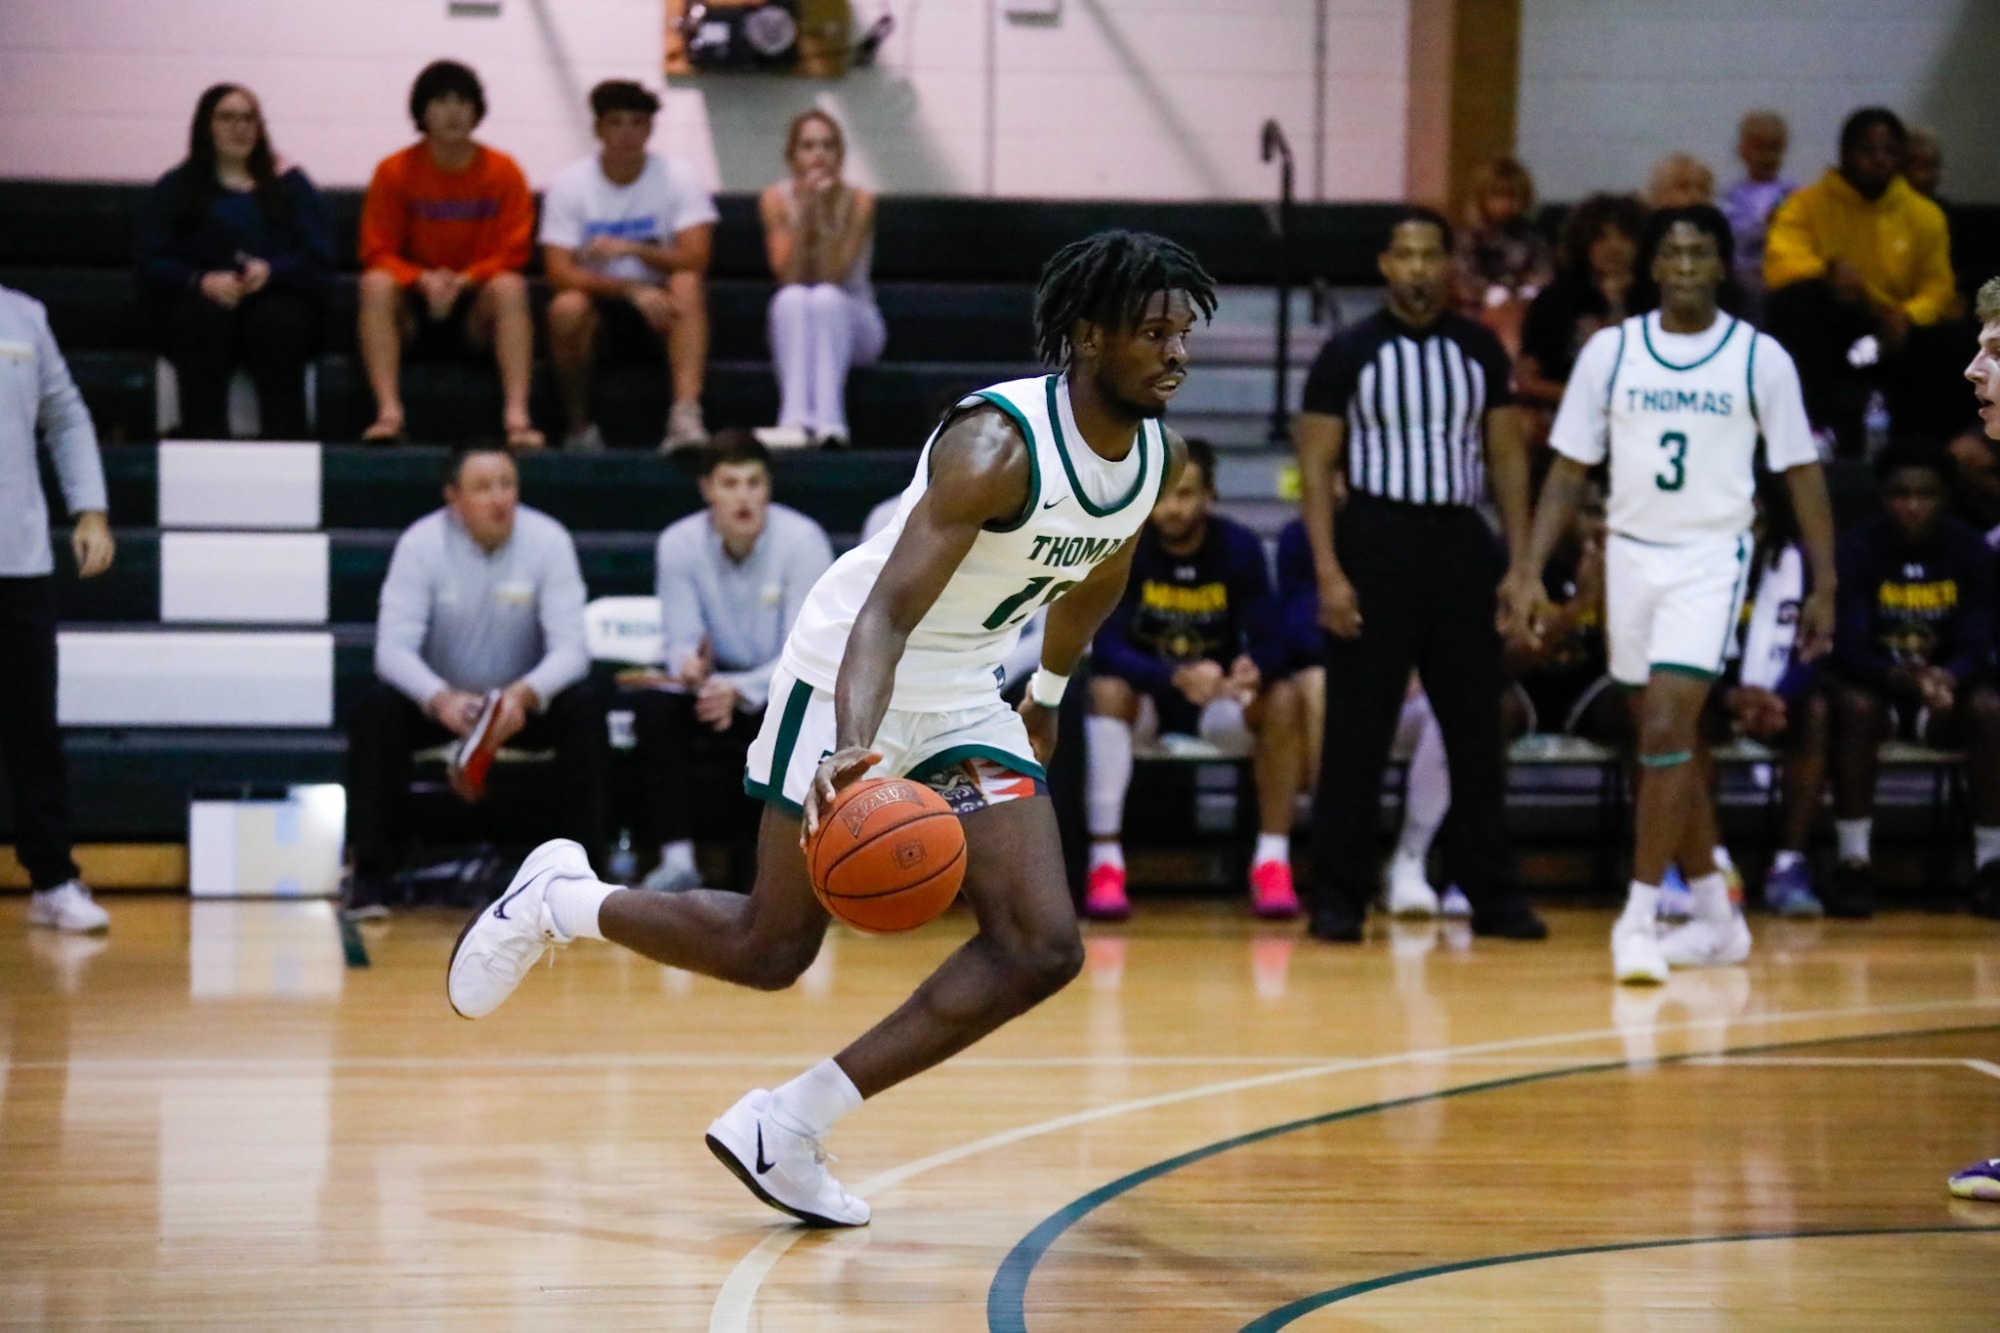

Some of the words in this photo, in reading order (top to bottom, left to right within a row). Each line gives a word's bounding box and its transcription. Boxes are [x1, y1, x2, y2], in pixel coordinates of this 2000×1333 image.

[1626, 388, 1733, 415] THOMAS
[1655, 430, 1688, 491] 3
[1026, 534, 1126, 567] THOMA
